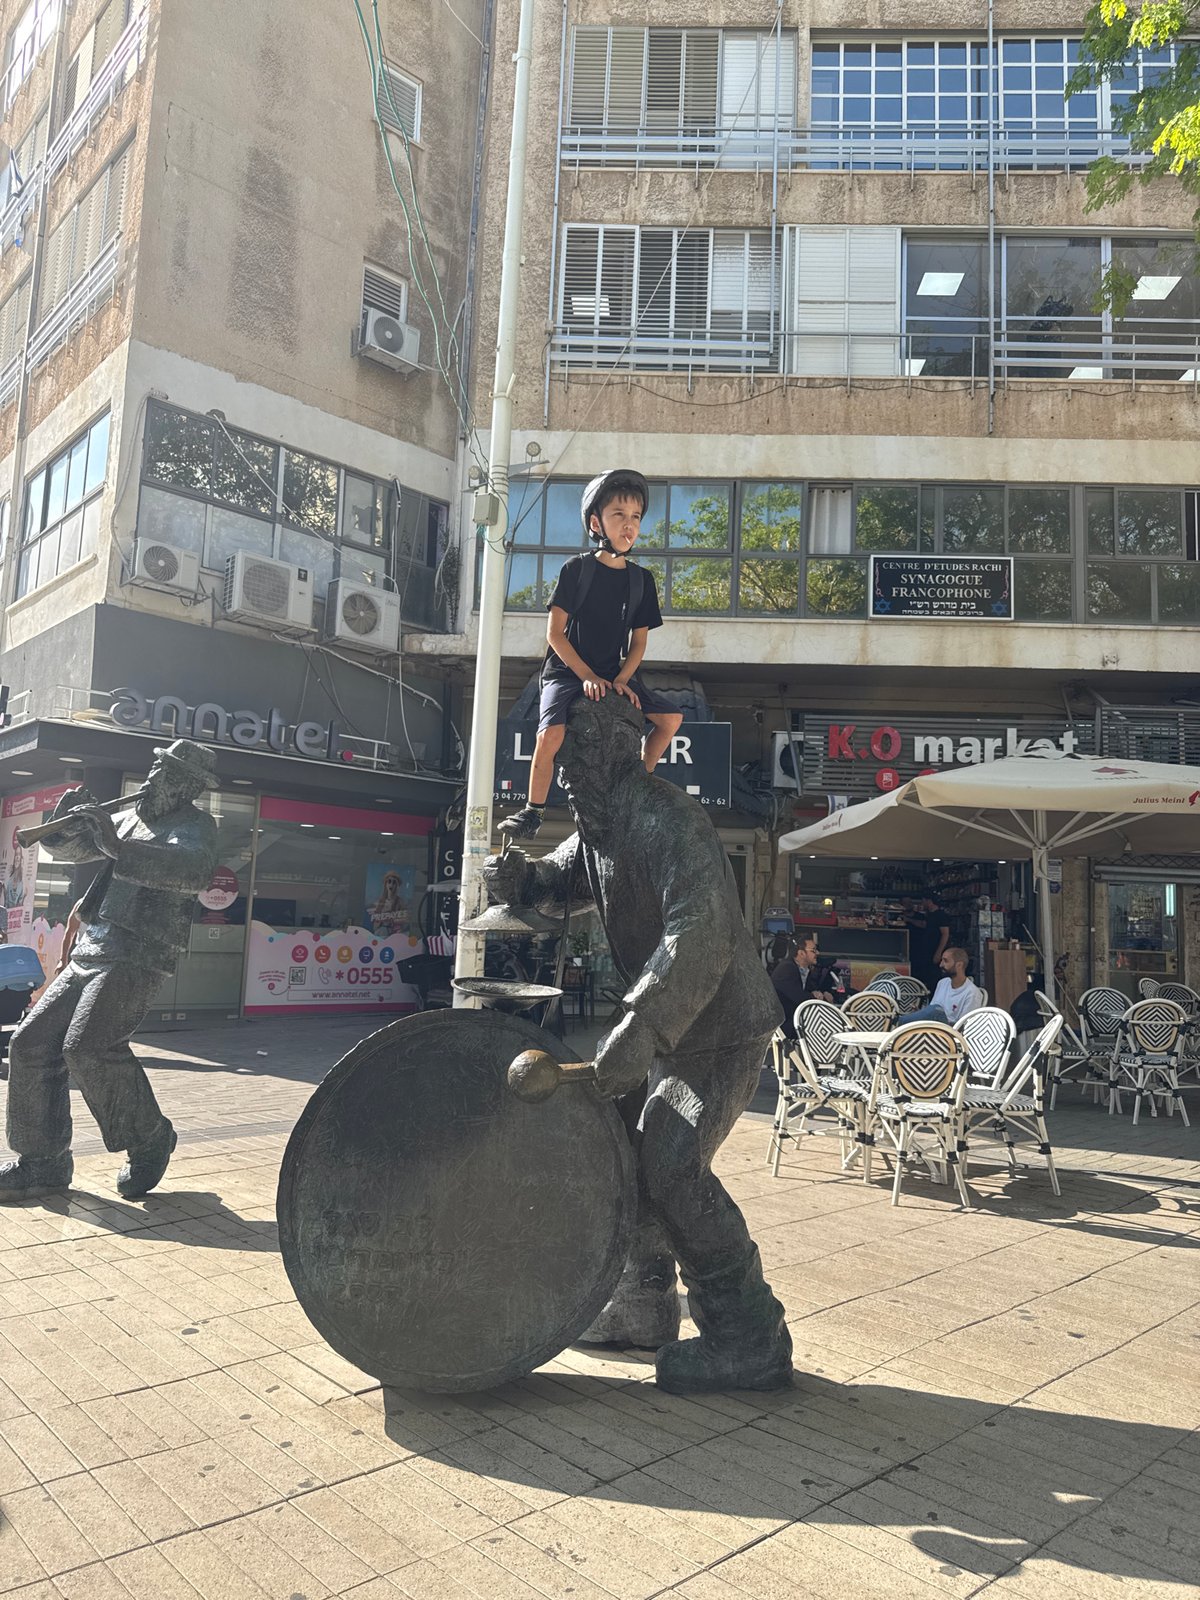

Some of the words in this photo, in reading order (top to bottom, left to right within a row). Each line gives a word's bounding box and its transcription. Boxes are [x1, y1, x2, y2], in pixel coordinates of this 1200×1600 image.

[882, 562, 920, 571] CENTRE
[924, 563, 970, 571] D'ETUDES
[971, 564, 1002, 572] RACHI
[900, 574, 983, 586] SYNAGOGUE
[891, 587, 992, 599] FRANCOPHONE
[932, 601, 958, 609] מדרש
[960, 601, 976, 610] בית
[828, 725, 901, 761] K.O
[501, 792, 511, 800] 04
[512, 793, 526, 801] 770
[701, 796, 710, 804] 62
[716, 797, 726, 806] 62
[312, 990, 371, 999] www.annatel.net
